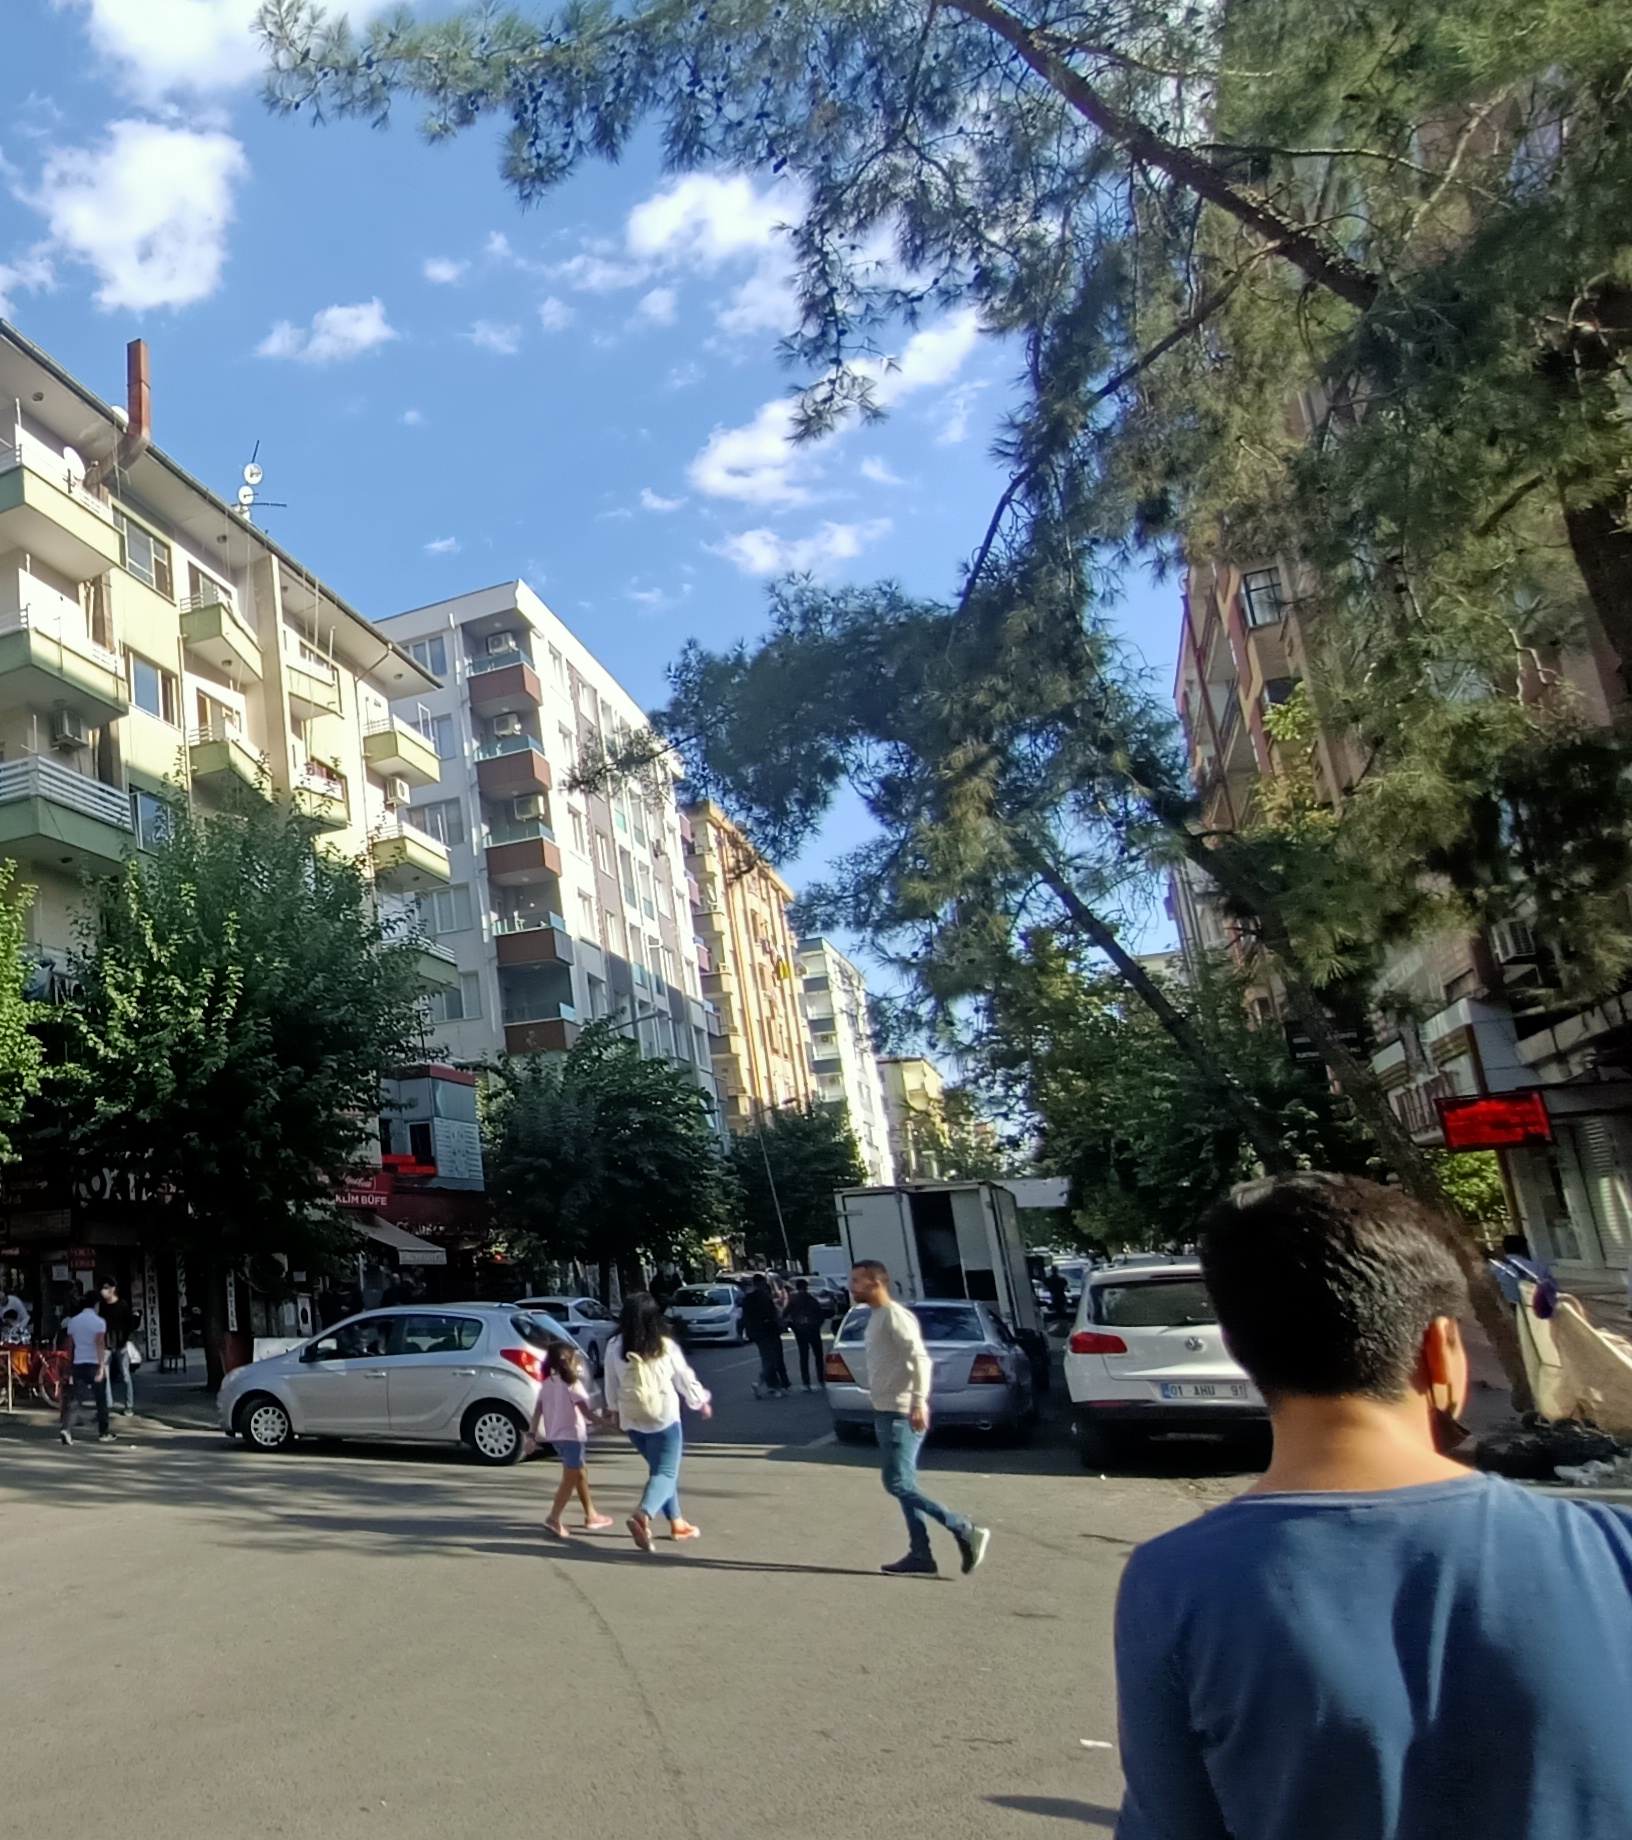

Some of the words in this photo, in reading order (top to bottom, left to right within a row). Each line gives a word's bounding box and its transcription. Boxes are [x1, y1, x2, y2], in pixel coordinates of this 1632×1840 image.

[335, 1193, 359, 1204] KLİM
[361, 1193, 387, 1206] BÜFE
[1170, 1385, 1184, 1397] 01
[1193, 1385, 1217, 1397] AHU
[1230, 1384, 1244, 1397] 91
